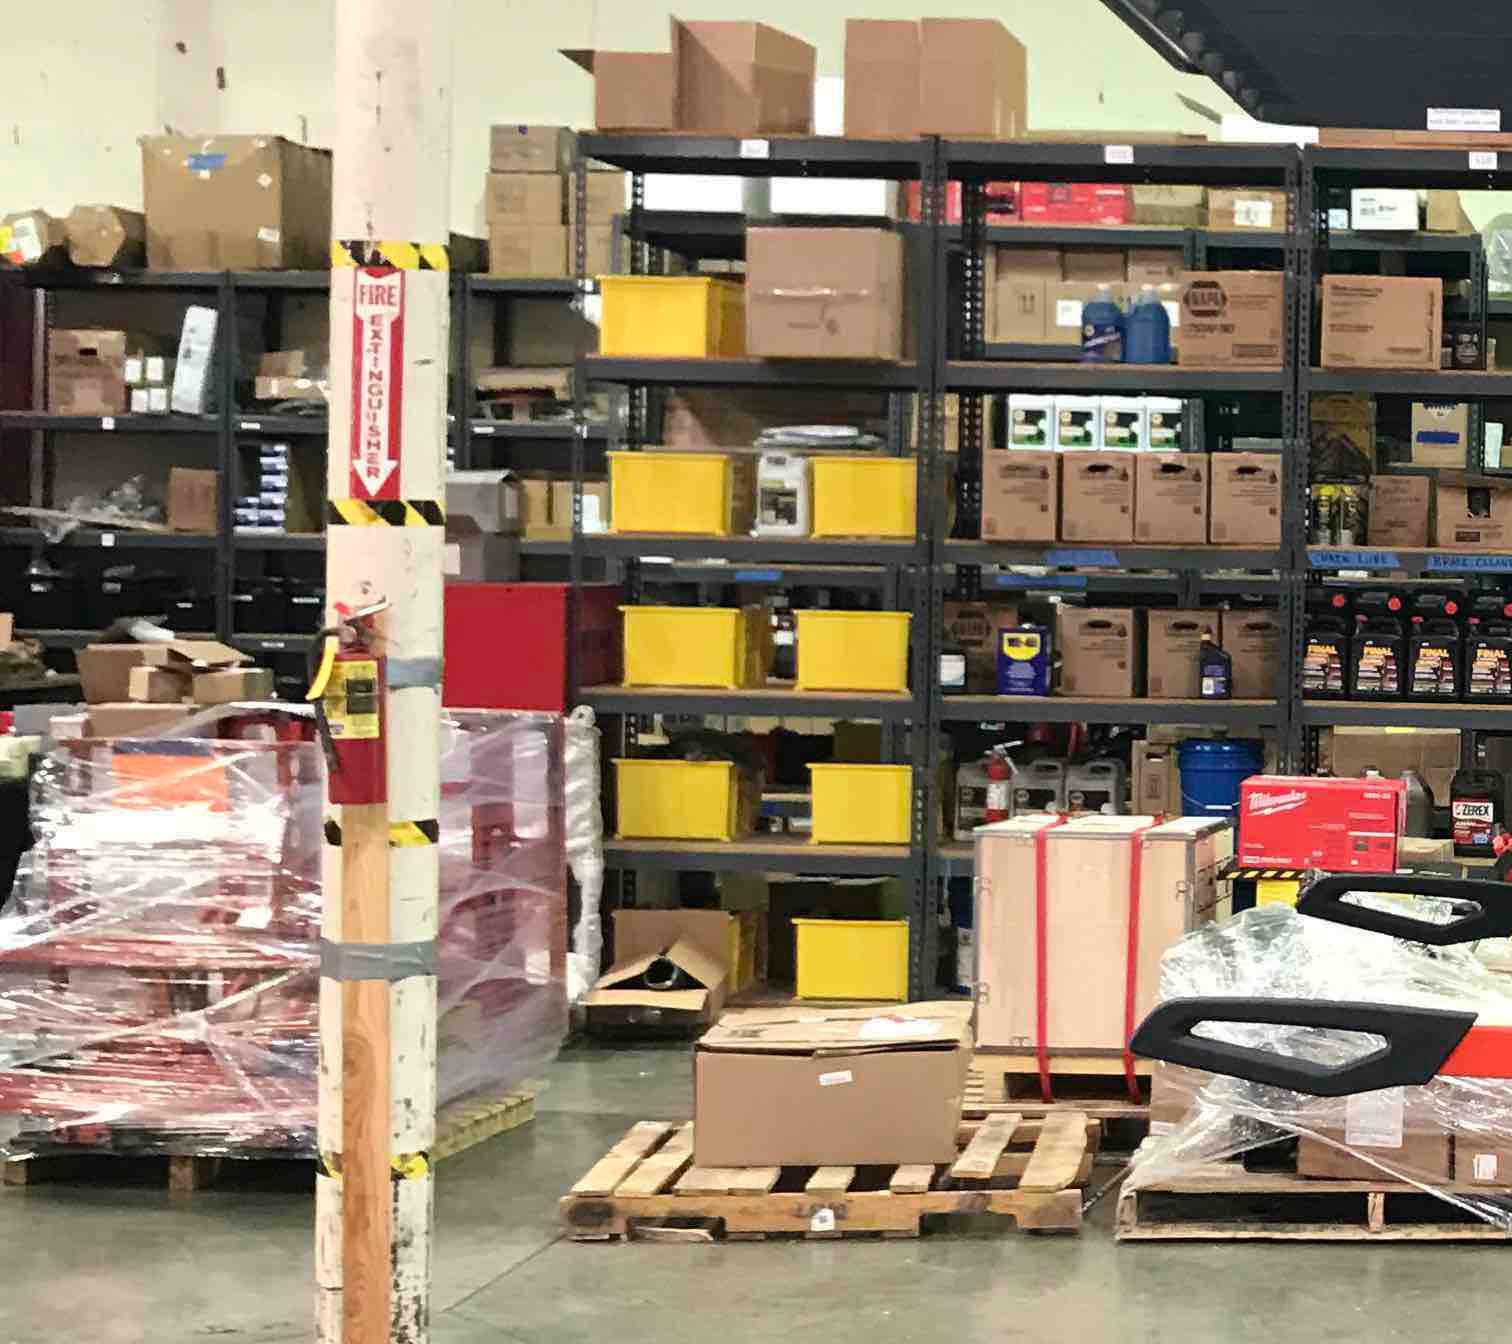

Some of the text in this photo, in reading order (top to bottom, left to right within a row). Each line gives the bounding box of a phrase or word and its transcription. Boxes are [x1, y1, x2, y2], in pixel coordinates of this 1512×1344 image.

[359, 284, 398, 306] FIRE
[366, 313, 384, 480] EXTINGUISHER
[1363, 646, 1392, 655] FINAL
[1419, 648, 1449, 657] FINAL
[1476, 649, 1506, 658] FINAL
[1462, 805, 1490, 817] ZEREX
